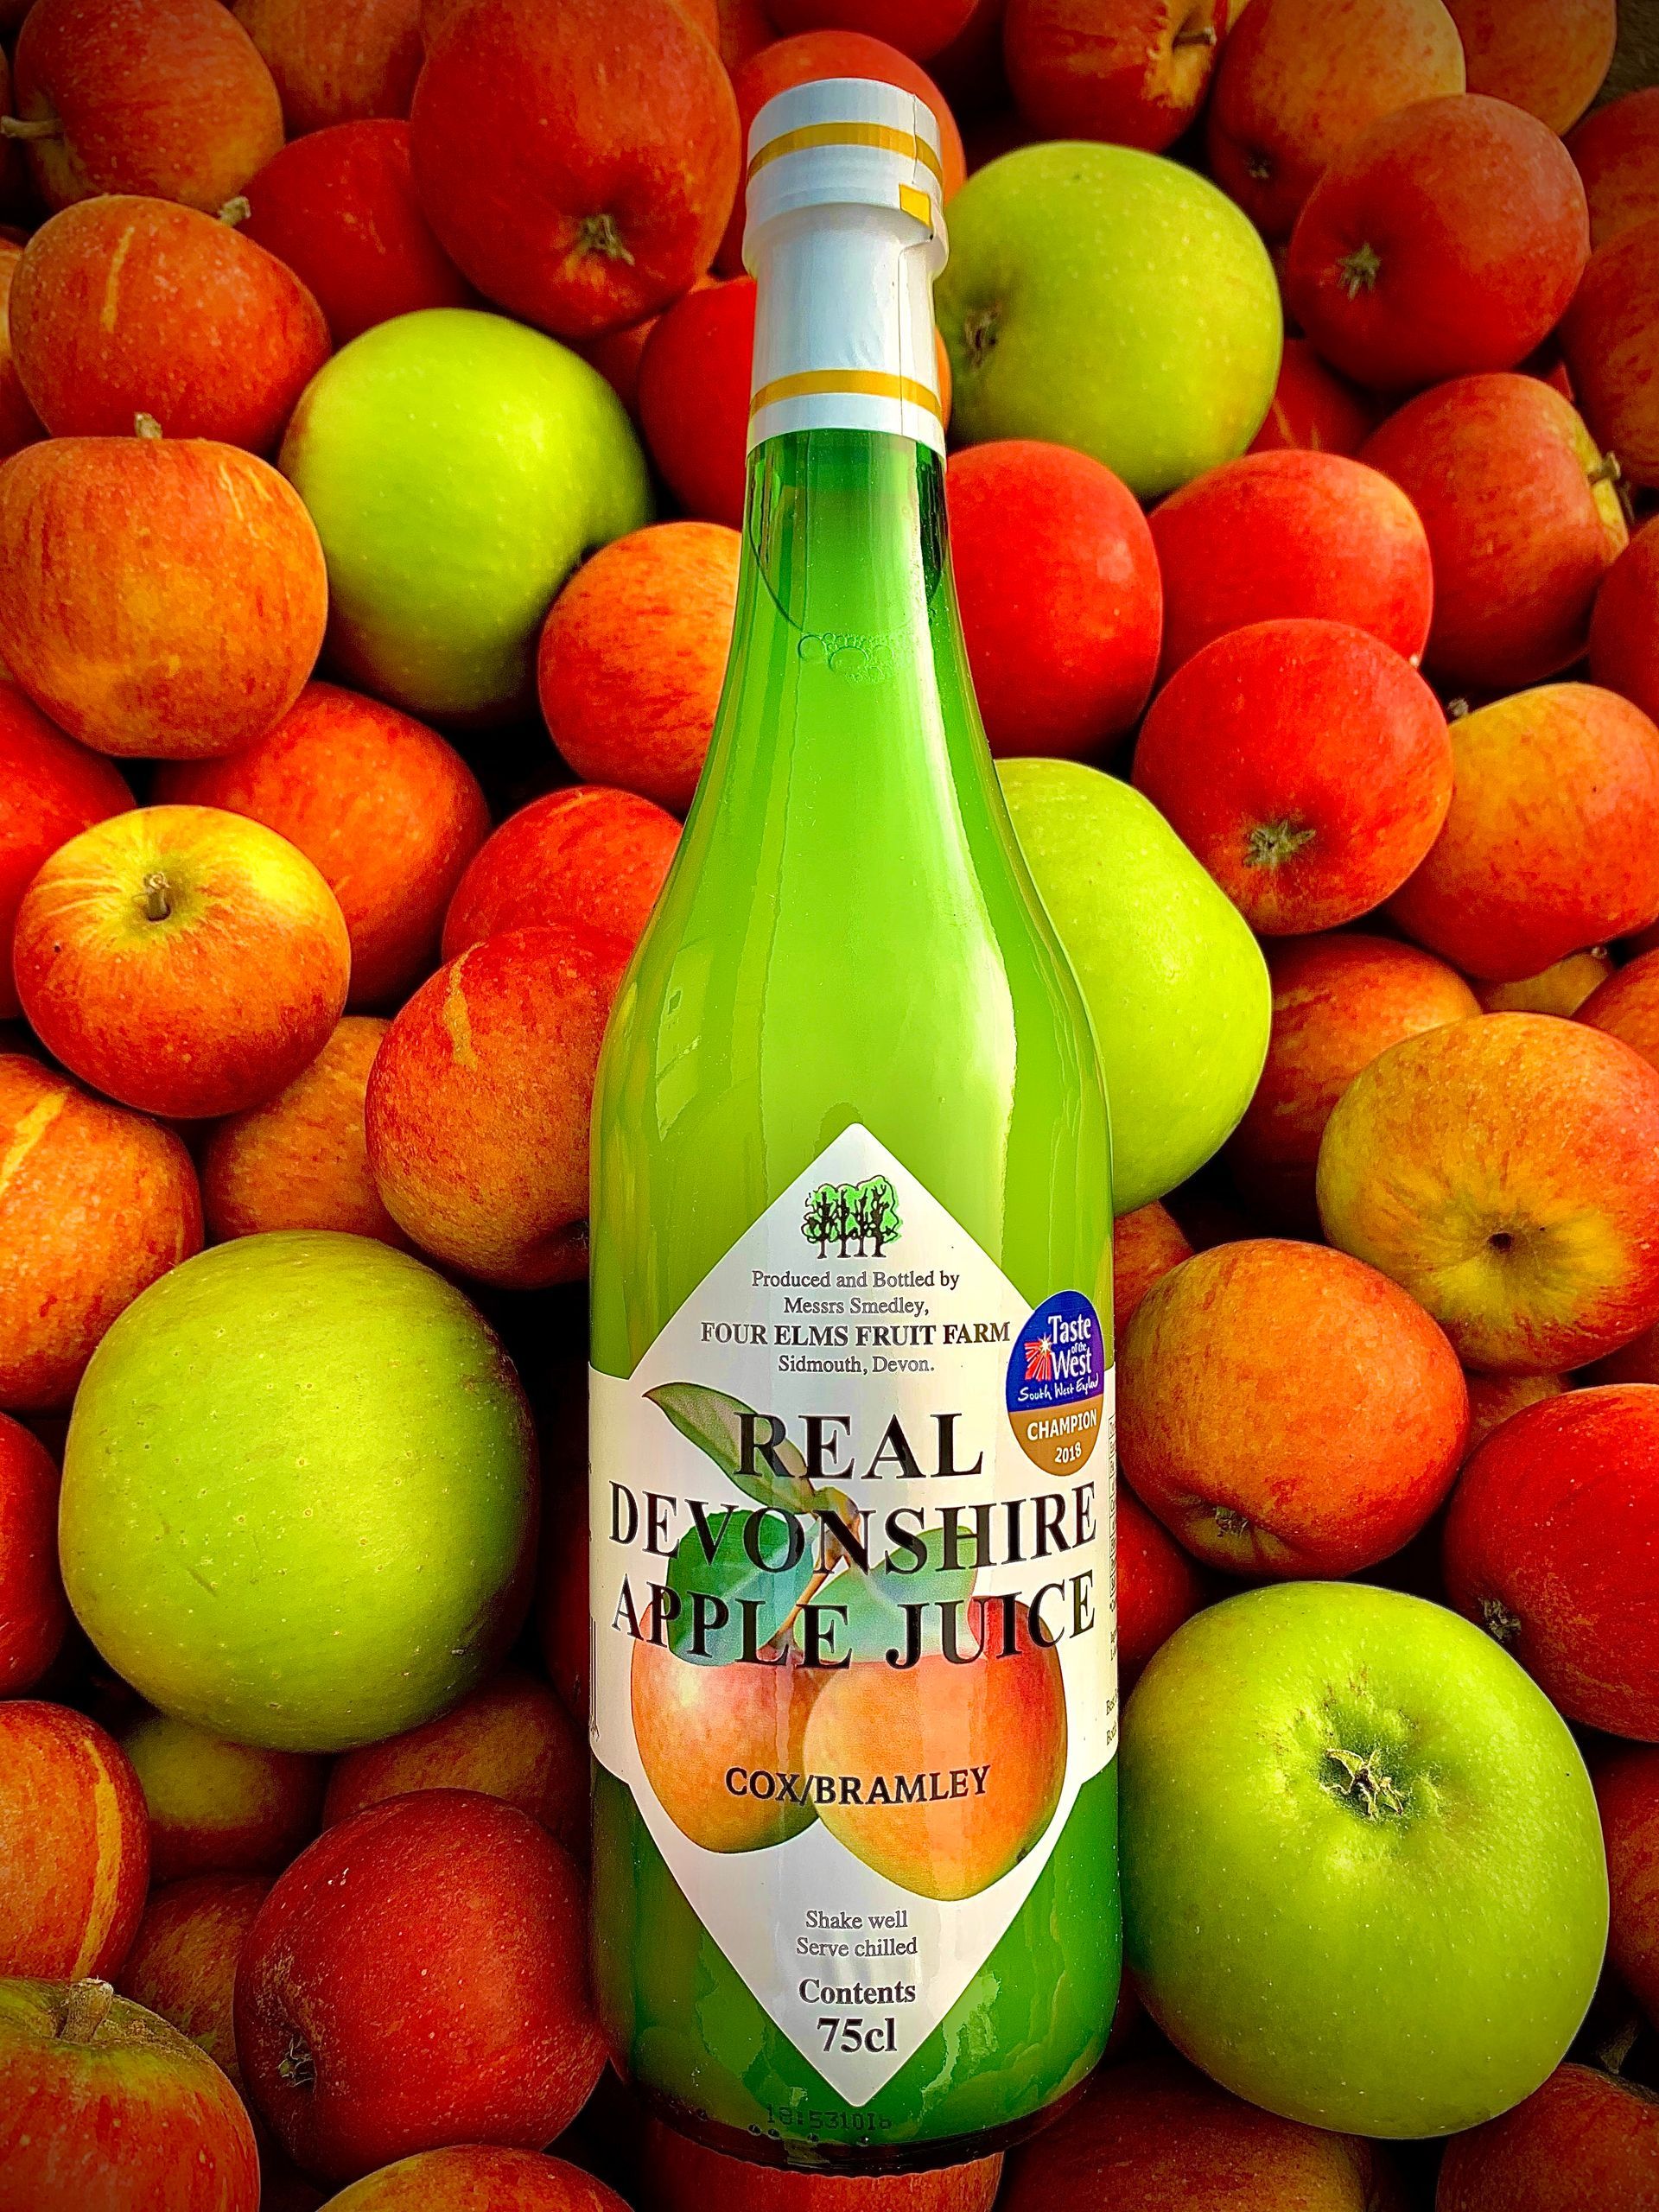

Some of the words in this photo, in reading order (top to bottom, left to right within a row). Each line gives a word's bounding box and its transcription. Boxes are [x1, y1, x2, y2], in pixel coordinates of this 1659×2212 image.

[752, 1270, 830, 1287] Produced
[836, 1270, 867, 1287] and
[873, 1270, 934, 1287] Bottled
[940, 1270, 959, 1289] by
[783, 1298, 844, 1313] Messrs
[850, 1297, 929, 1317] Smedley,
[701, 1322, 767, 1345] FOUR
[774, 1325, 849, 1346] ELMS
[855, 1325, 936, 1346] FRUIT
[943, 1321, 1010, 1344] FARM
[1048, 1314, 1091, 1344] Taste
[778, 1355, 868, 1376] Sidmouth,
[873, 1356, 934, 1372] Devon.
[1050, 1347, 1091, 1380] West
[1018, 1384, 1052, 1402] South
[1054, 1382, 1074, 1398] West
[1027, 1408, 1097, 1441] CHAMPION
[734, 1412, 983, 1480] REAL
[1054, 1442, 1082, 1463] 2018
[609, 1481, 1096, 1575] DEVONSHIRE
[611, 1573, 853, 1669] APPLE
[885, 1570, 1096, 1670] JUICE
[726, 1764, 991, 1806] COX/BRAMLEY
[805, 1910, 863, 1929] Shake
[868, 1910, 908, 1929] well
[797, 1937, 849, 1956] Serve
[854, 1937, 918, 1957] chilled
[798, 1979, 916, 2005] Contents
[817, 2018, 898, 2053] 75cl
